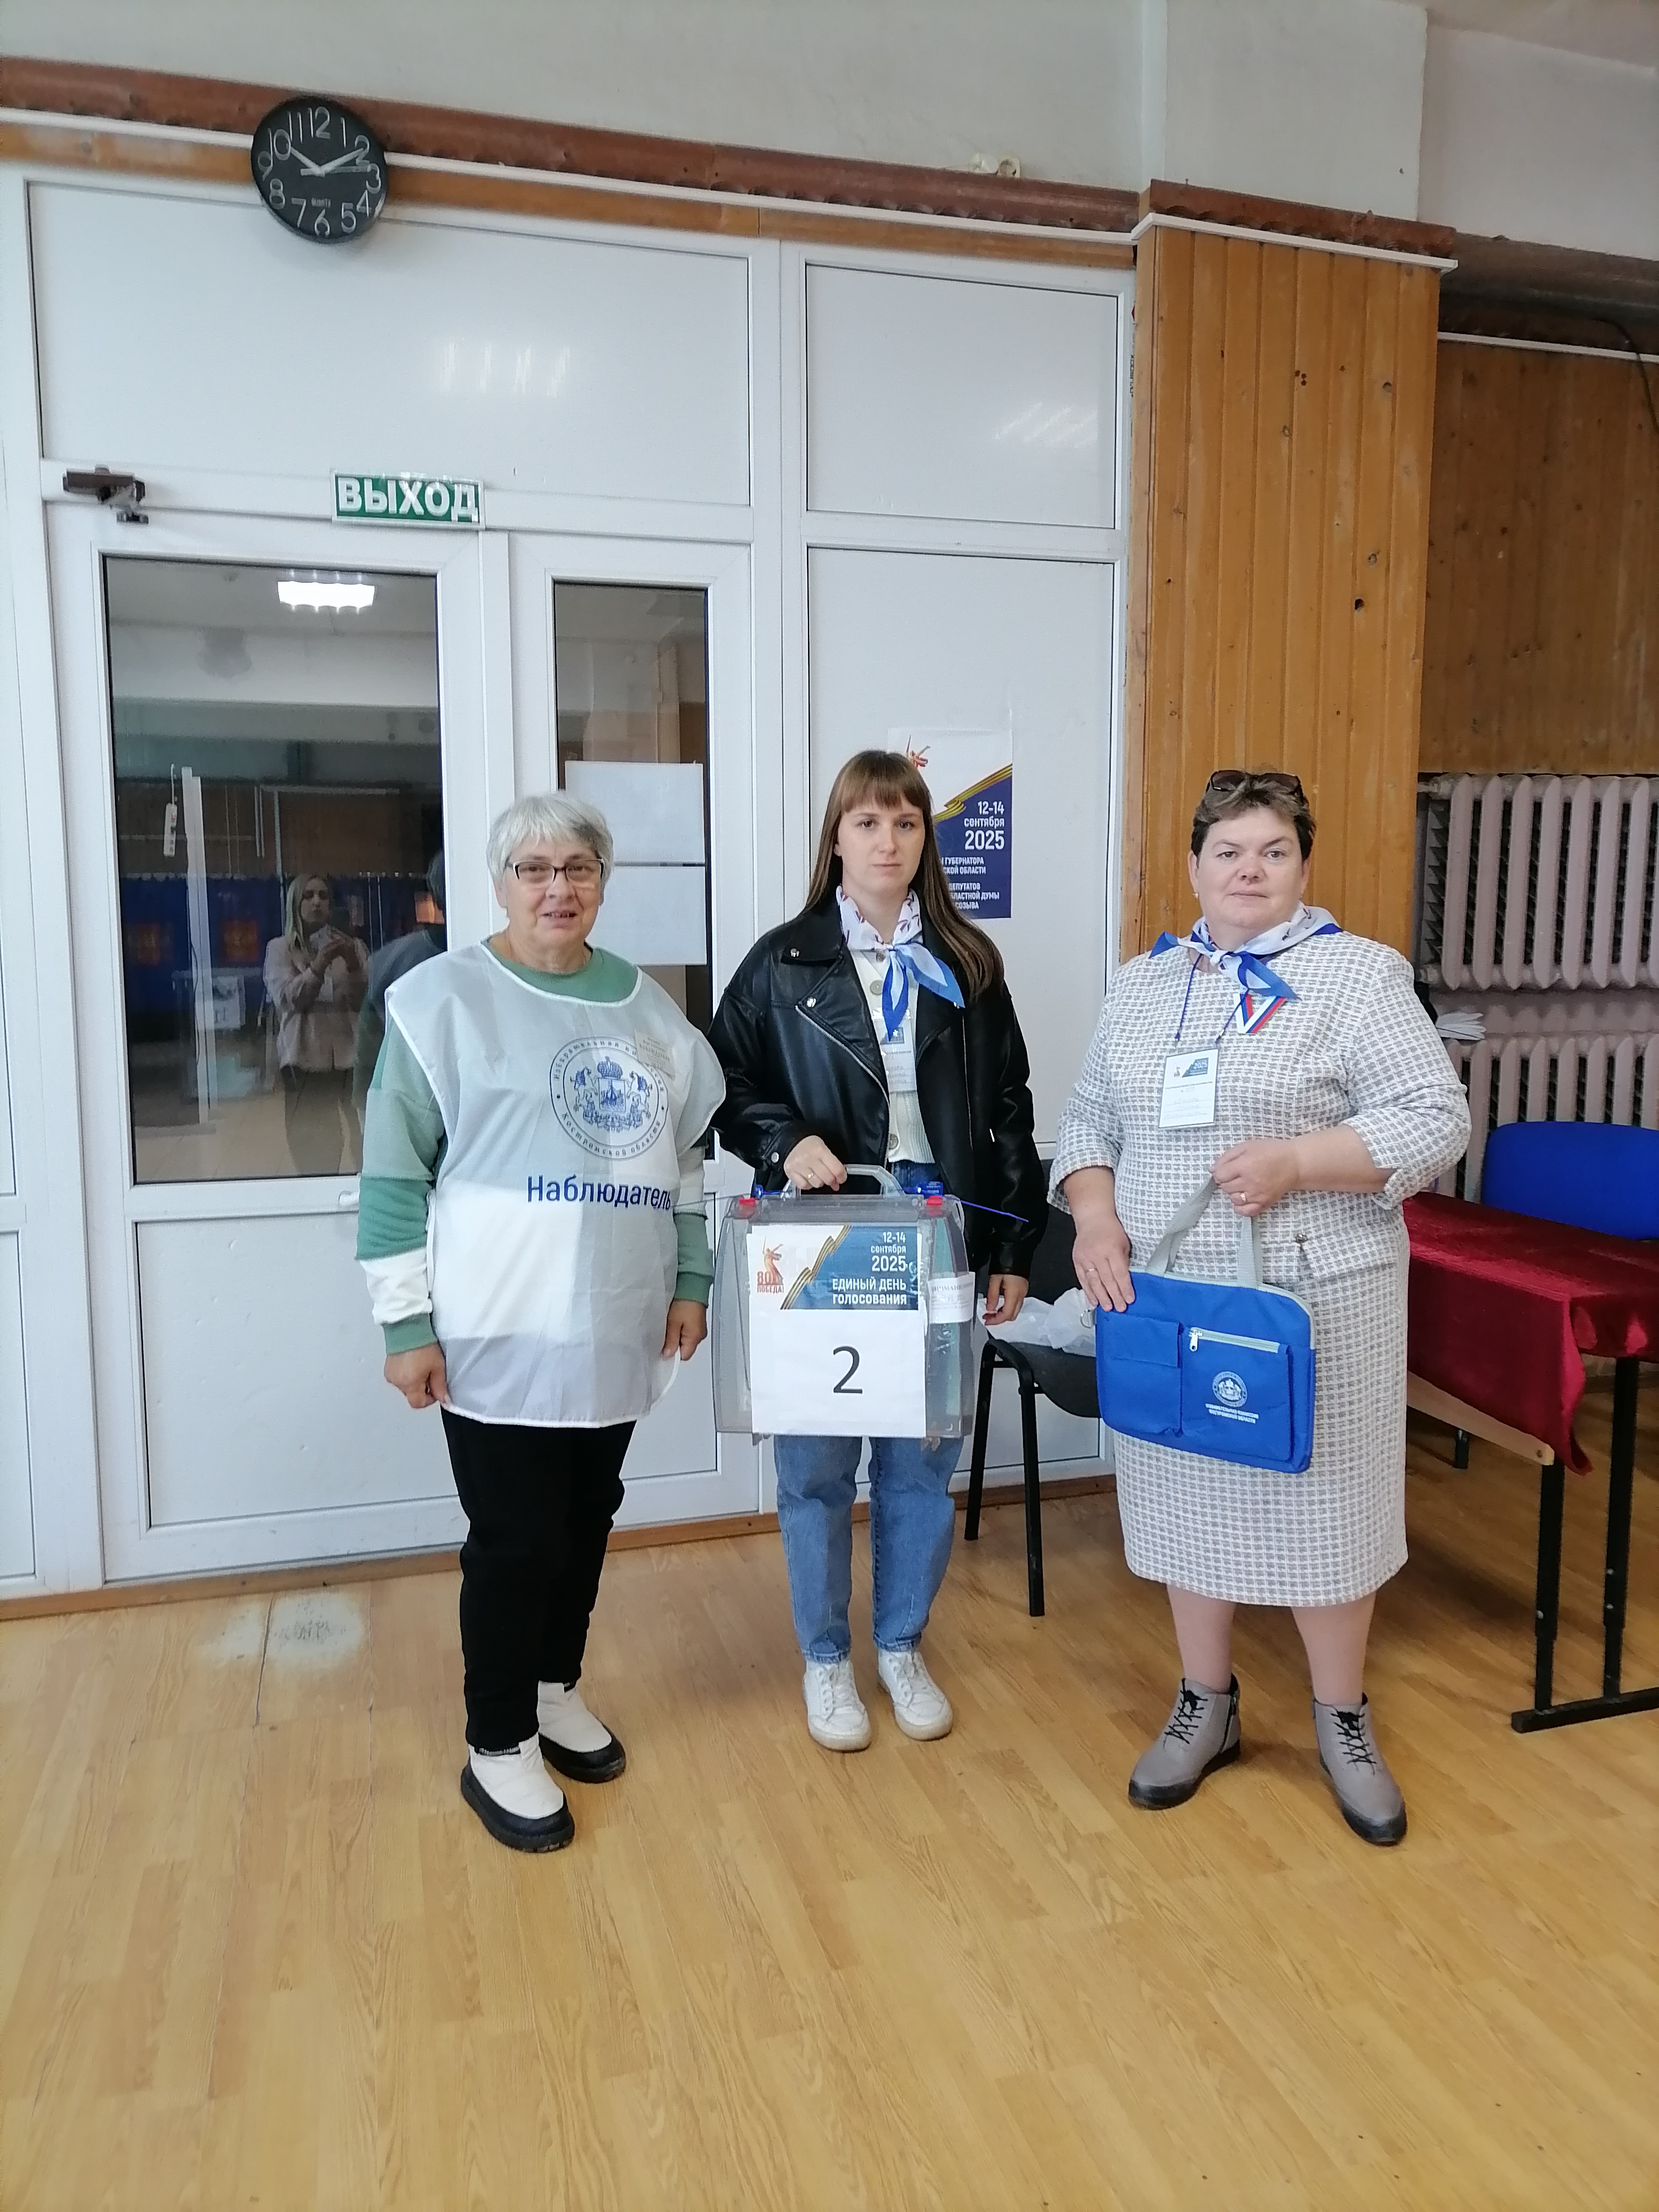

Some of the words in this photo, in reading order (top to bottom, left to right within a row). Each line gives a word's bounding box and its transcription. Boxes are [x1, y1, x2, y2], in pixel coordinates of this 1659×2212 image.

[287, 111, 303, 144] 11
[307, 106, 331, 139] 12
[340, 117, 346, 148] 1
[267, 128, 291, 161] 10
[354, 134, 371, 166] 2
[257, 150, 273, 181] 9
[366, 163, 382, 194] 3
[269, 178, 286, 210] 8
[356, 189, 372, 218] 4
[291, 197, 306, 228] 7
[314, 208, 330, 237] 6
[341, 202, 357, 234] 5
[338, 476, 478, 523] ВЫХОД
[964, 815, 1005, 830] сентября
[977, 801, 1005, 815] 12-14
[964, 830, 1005, 851] 2025
[945, 857, 984, 865] ГУБЕРНАТОРА
[959, 867, 987, 875] ОБЛАСТИ
[948, 883, 981, 891] ДЕПУТАТОВ
[981, 891, 1000, 901] ДУМЫ
[528, 1173, 671, 1211] Наблюдатель
[870, 1244, 906, 1255] сентября
[883, 1232, 906, 1243] 12-14
[757, 1271, 773, 1285] 80
[872, 1255, 906, 1272] 2025
[832, 1276, 877, 1292] ЕДИНЫЙ
[879, 1278, 907, 1292] ДЕНЬ
[832, 1345, 863, 1394] 2
